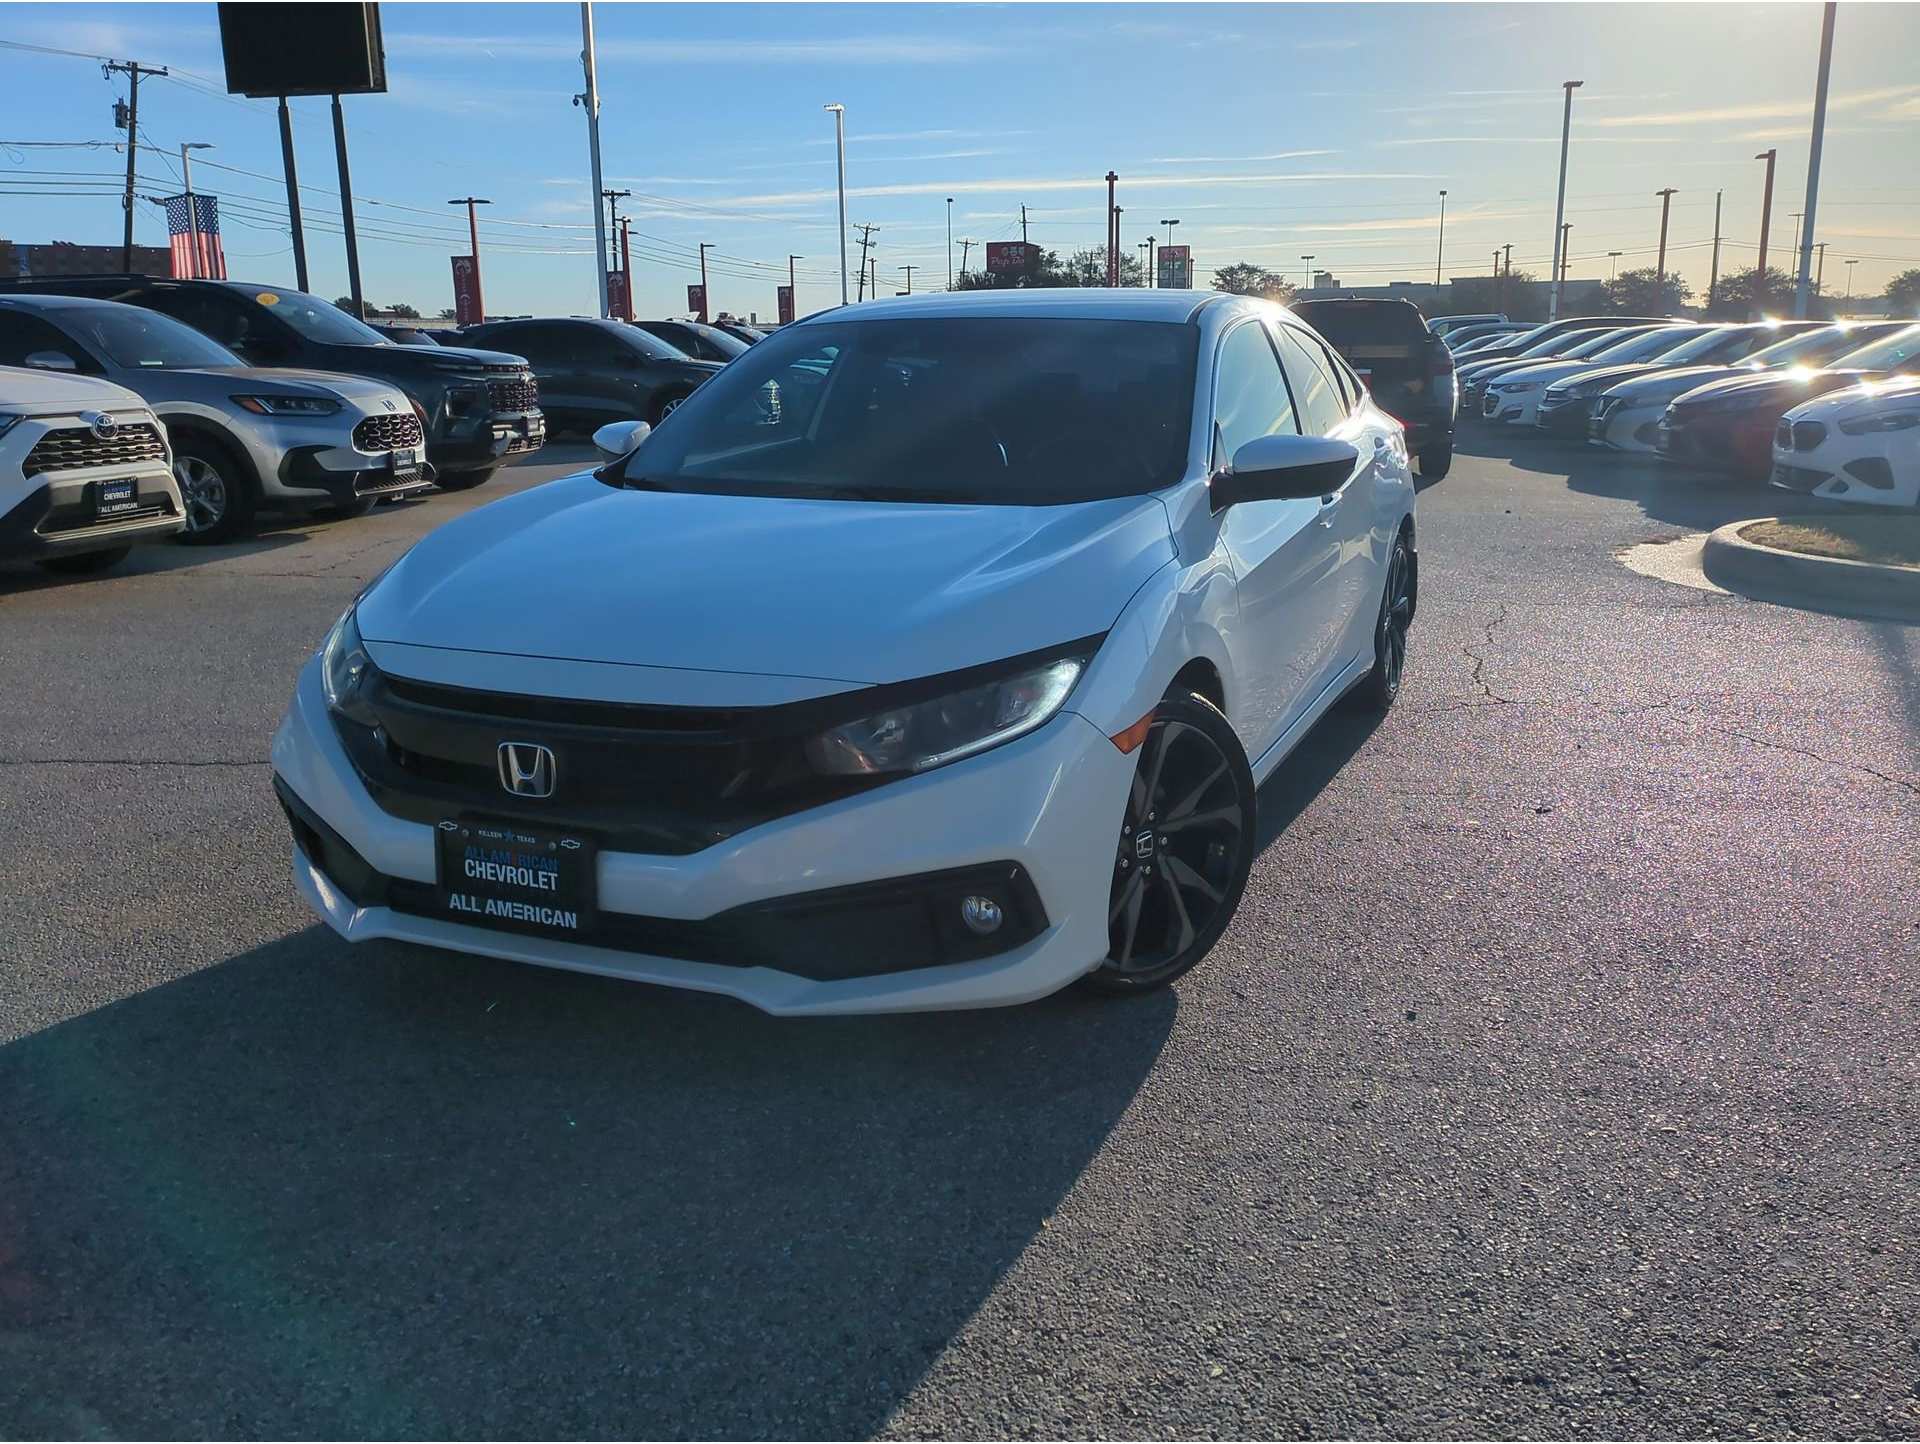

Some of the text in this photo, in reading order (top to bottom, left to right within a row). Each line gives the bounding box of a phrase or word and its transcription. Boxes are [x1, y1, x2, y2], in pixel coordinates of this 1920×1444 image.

[101, 505, 112, 513] ALL
[516, 834, 536, 844] TEXAS
[464, 845, 559, 871] ALL AMRICAN
[464, 859, 559, 891] CHEVROLET
[449, 893, 578, 929] ALL AMERICAN
